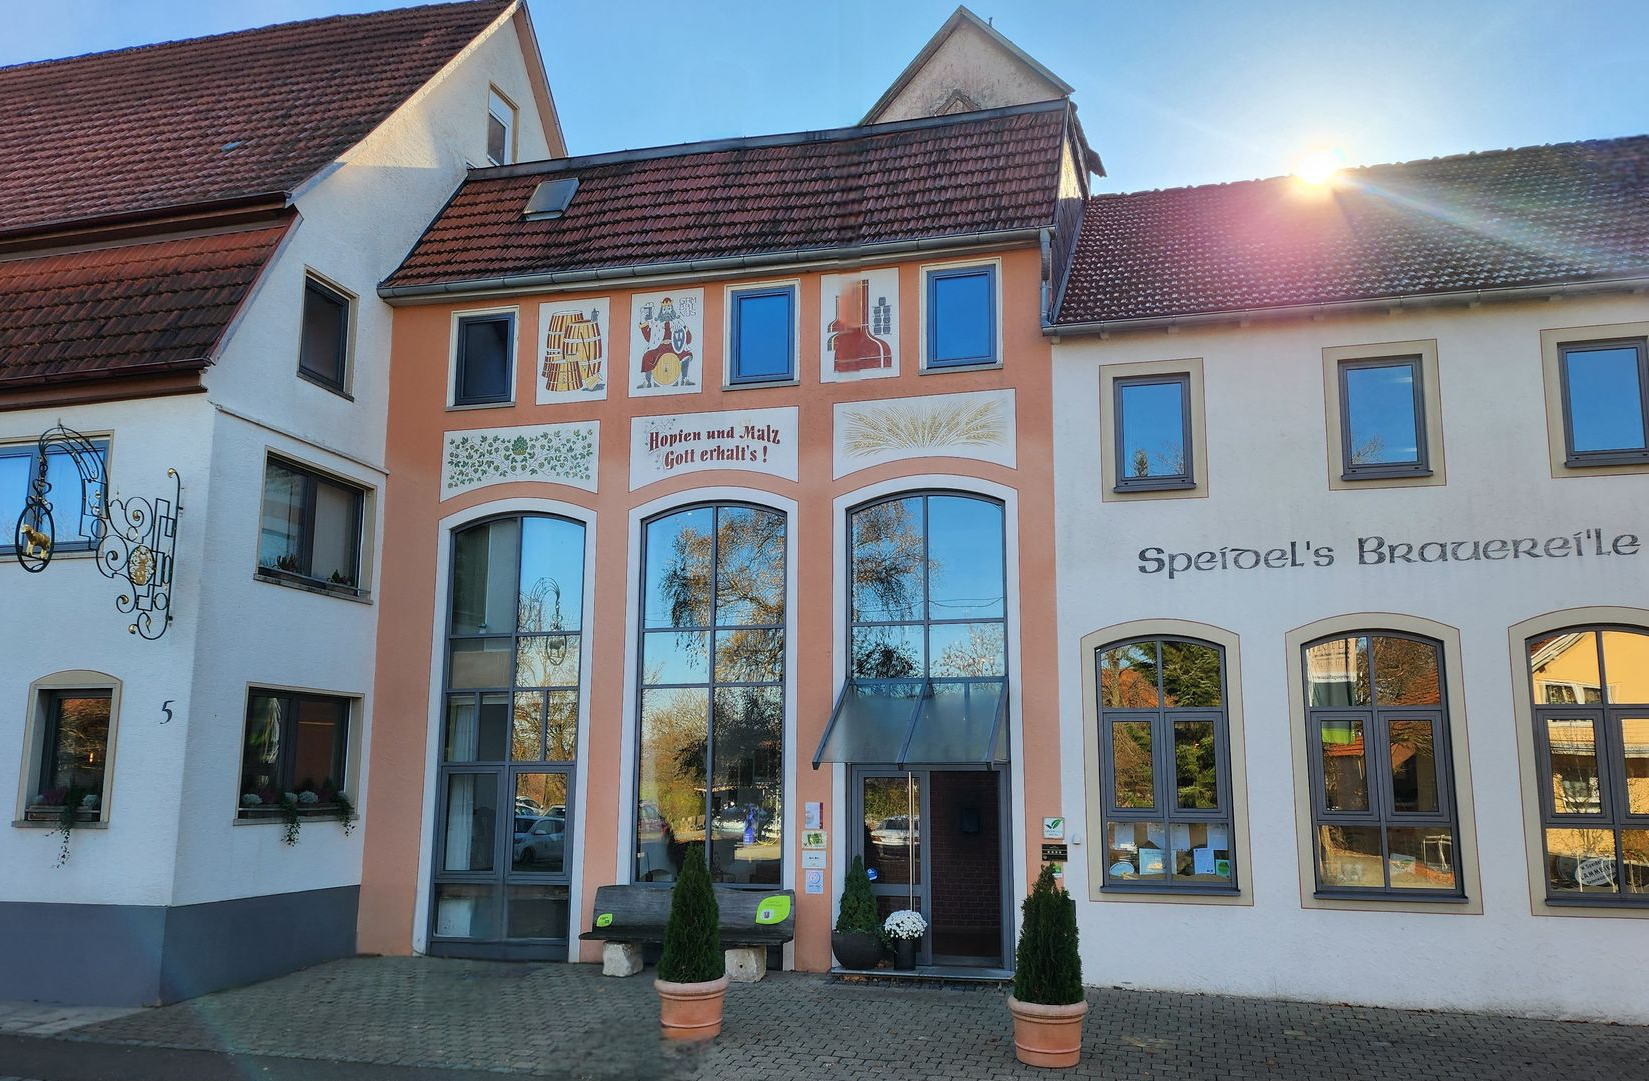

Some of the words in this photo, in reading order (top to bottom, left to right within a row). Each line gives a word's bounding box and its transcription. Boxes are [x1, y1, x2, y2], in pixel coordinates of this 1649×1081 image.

[649, 430, 701, 451] Hopfen
[706, 426, 735, 440] und
[739, 424, 781, 444] Malz
[664, 449, 696, 470] Gott
[1138, 540, 1335, 579] Speidel's
[159, 700, 176, 725] 5
